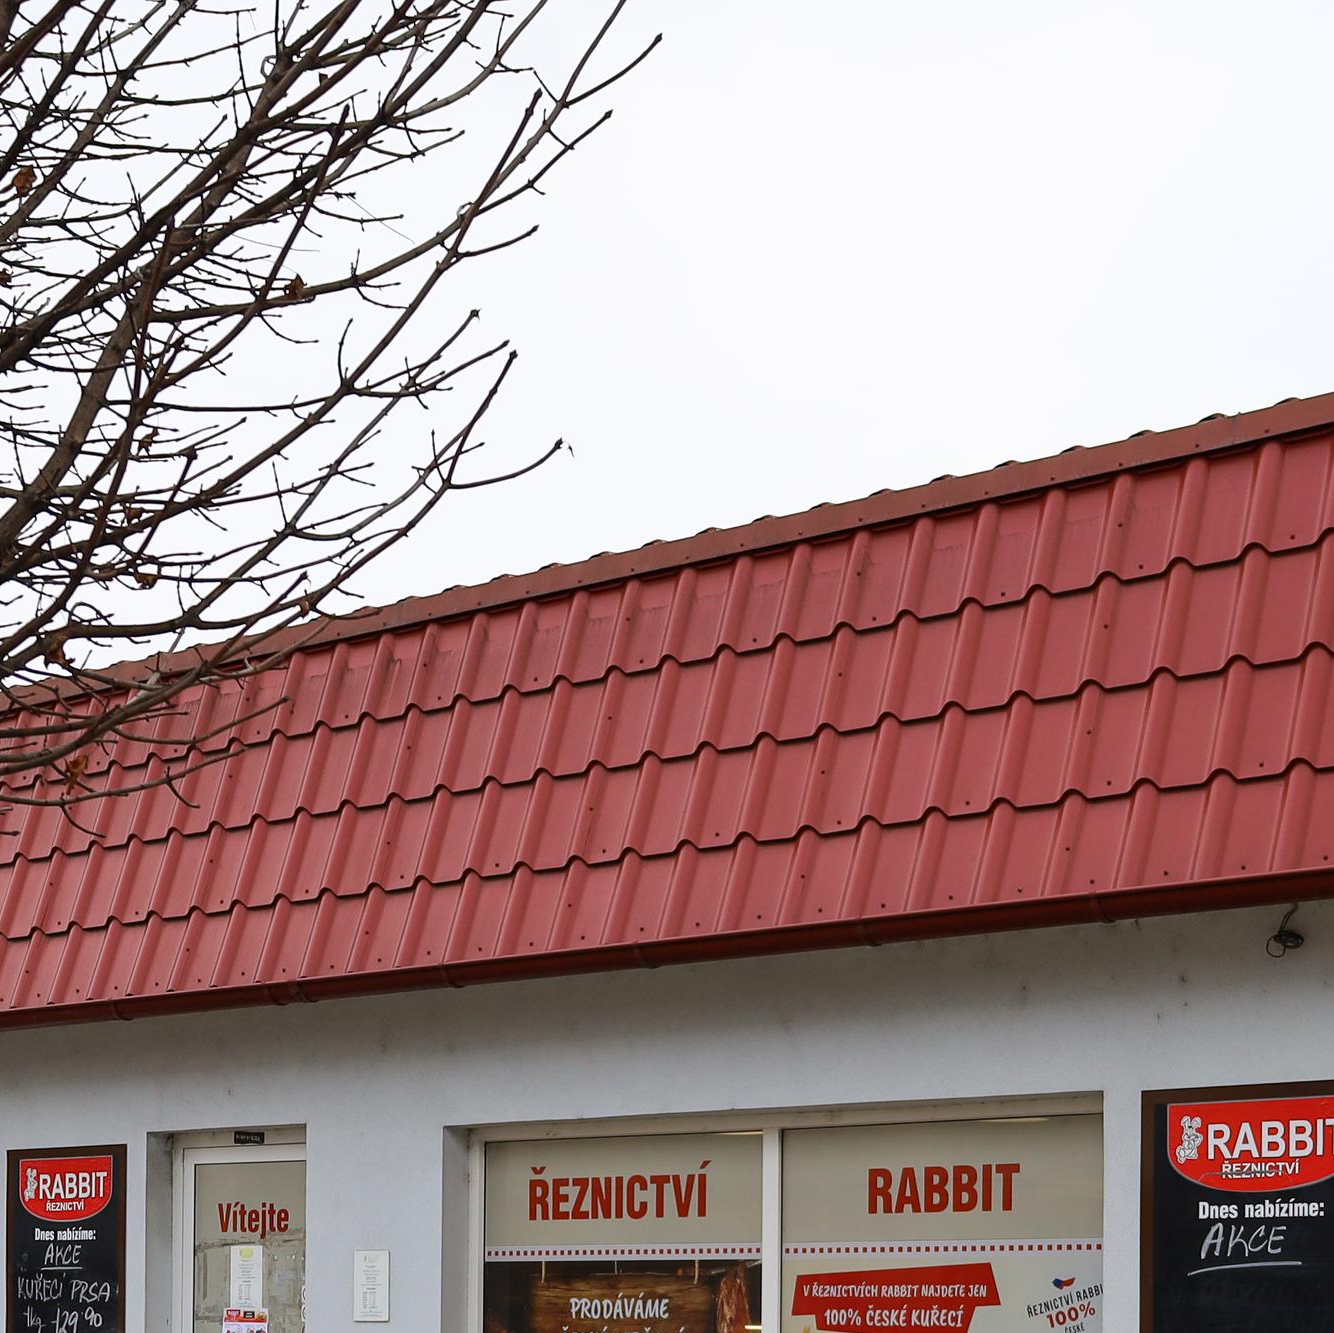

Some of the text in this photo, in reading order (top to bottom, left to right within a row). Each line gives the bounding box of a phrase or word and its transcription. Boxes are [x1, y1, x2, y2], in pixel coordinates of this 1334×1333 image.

[1221, 1157, 1300, 1178] ŘEZNICTVÍ
[39, 1171, 107, 1200] RABBIT
[529, 1160, 711, 1221] ŘEZNICTVÍ
[868, 1163, 1020, 1214] RABBIT
[46, 1199, 84, 1211] ŘEZNICTVÍ
[1198, 1198, 1325, 1219] Dnes nabízíme:
[218, 1201, 290, 1239] Vítejte
[35, 1227, 96, 1241] Dnes nabízíme:
[1200, 1222, 1287, 1260] AKCE
[44, 1243, 81, 1265] AKCE
[17, 1272, 111, 1303] KUŘECÍ PRSA
[803, 1282, 987, 1298] V ŘEZNICTVÍCH RABBIT NAJDETE JEN
[1027, 1283, 1103, 1318] ŘEZNICTVÍ RABBI
[570, 1292, 669, 1320] PRODÁVÁME
[824, 1305, 965, 1327] 100% ČESKÉ KUŘECÍ
[1046, 1301, 1096, 1328] 100%
